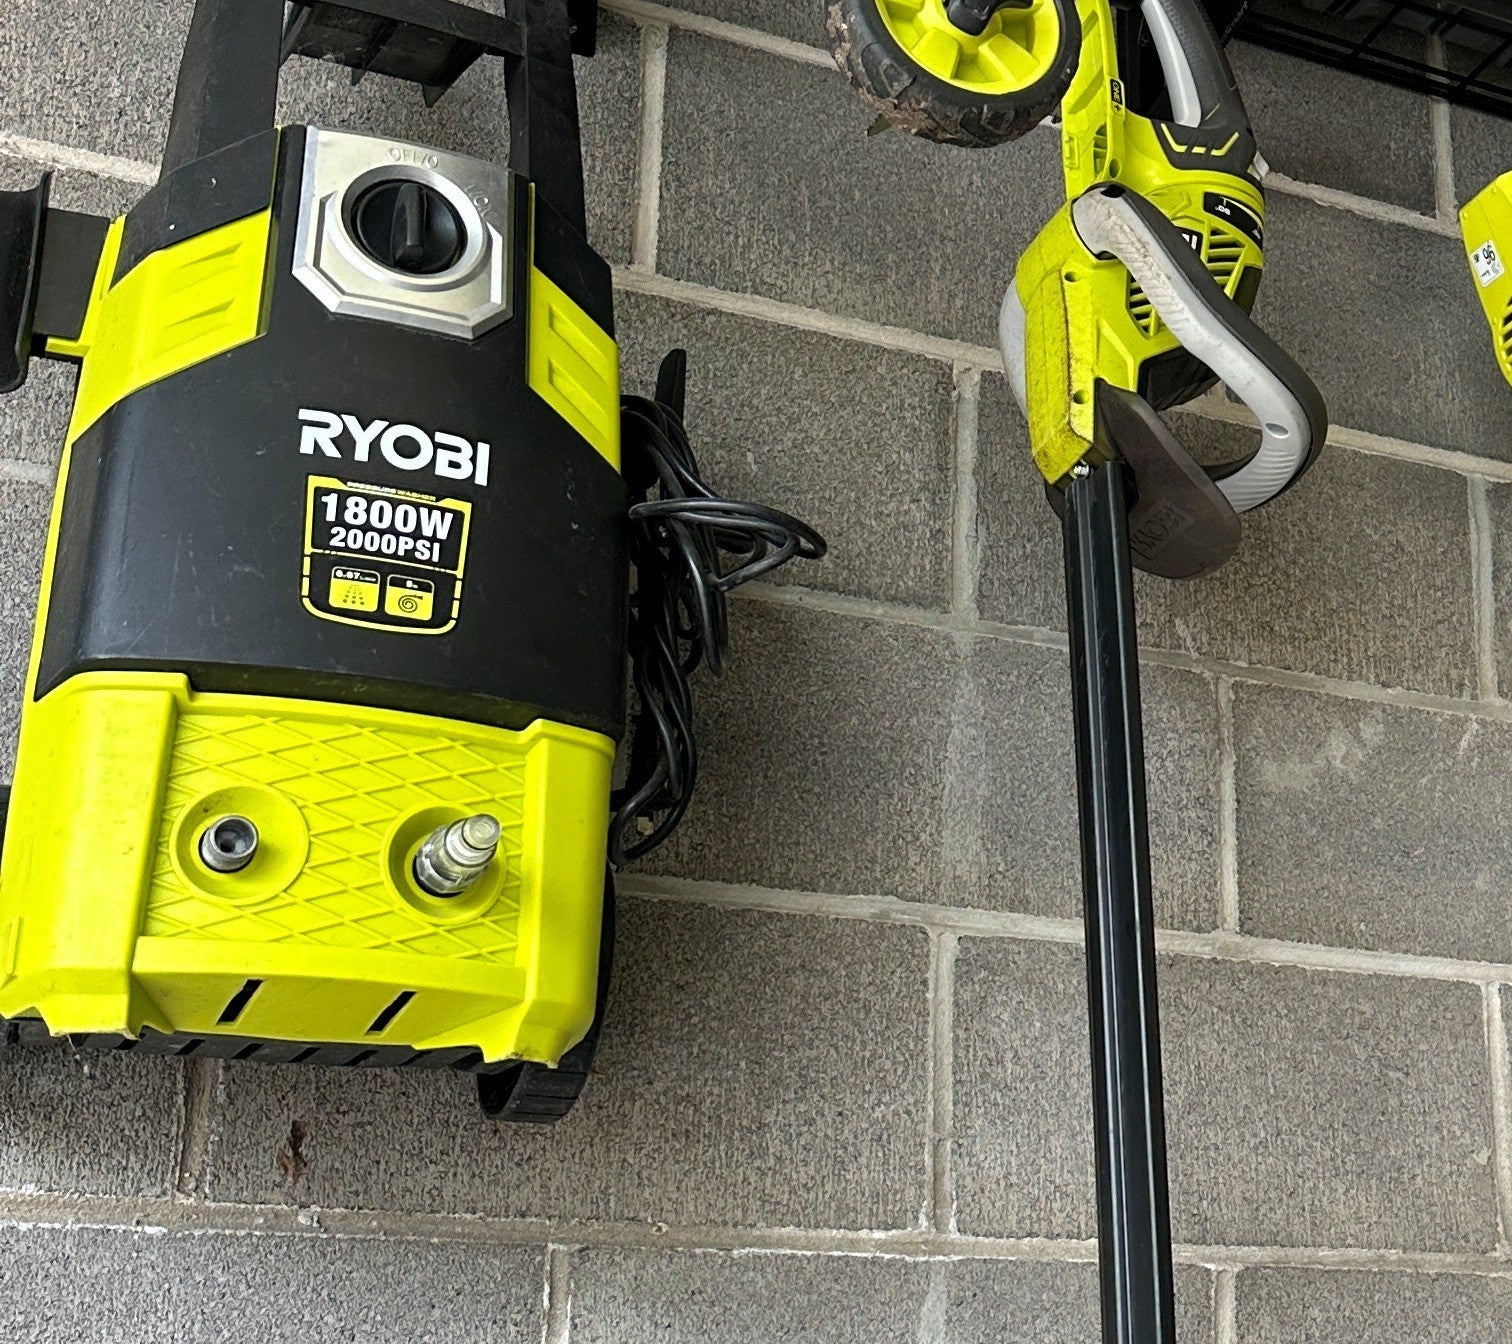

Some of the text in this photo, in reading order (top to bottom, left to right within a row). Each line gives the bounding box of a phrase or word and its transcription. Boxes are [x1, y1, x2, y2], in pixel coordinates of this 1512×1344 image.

[298, 408, 490, 487] RYOBI
[321, 492, 454, 540] 1800W
[329, 526, 441, 563] 2000PSI
